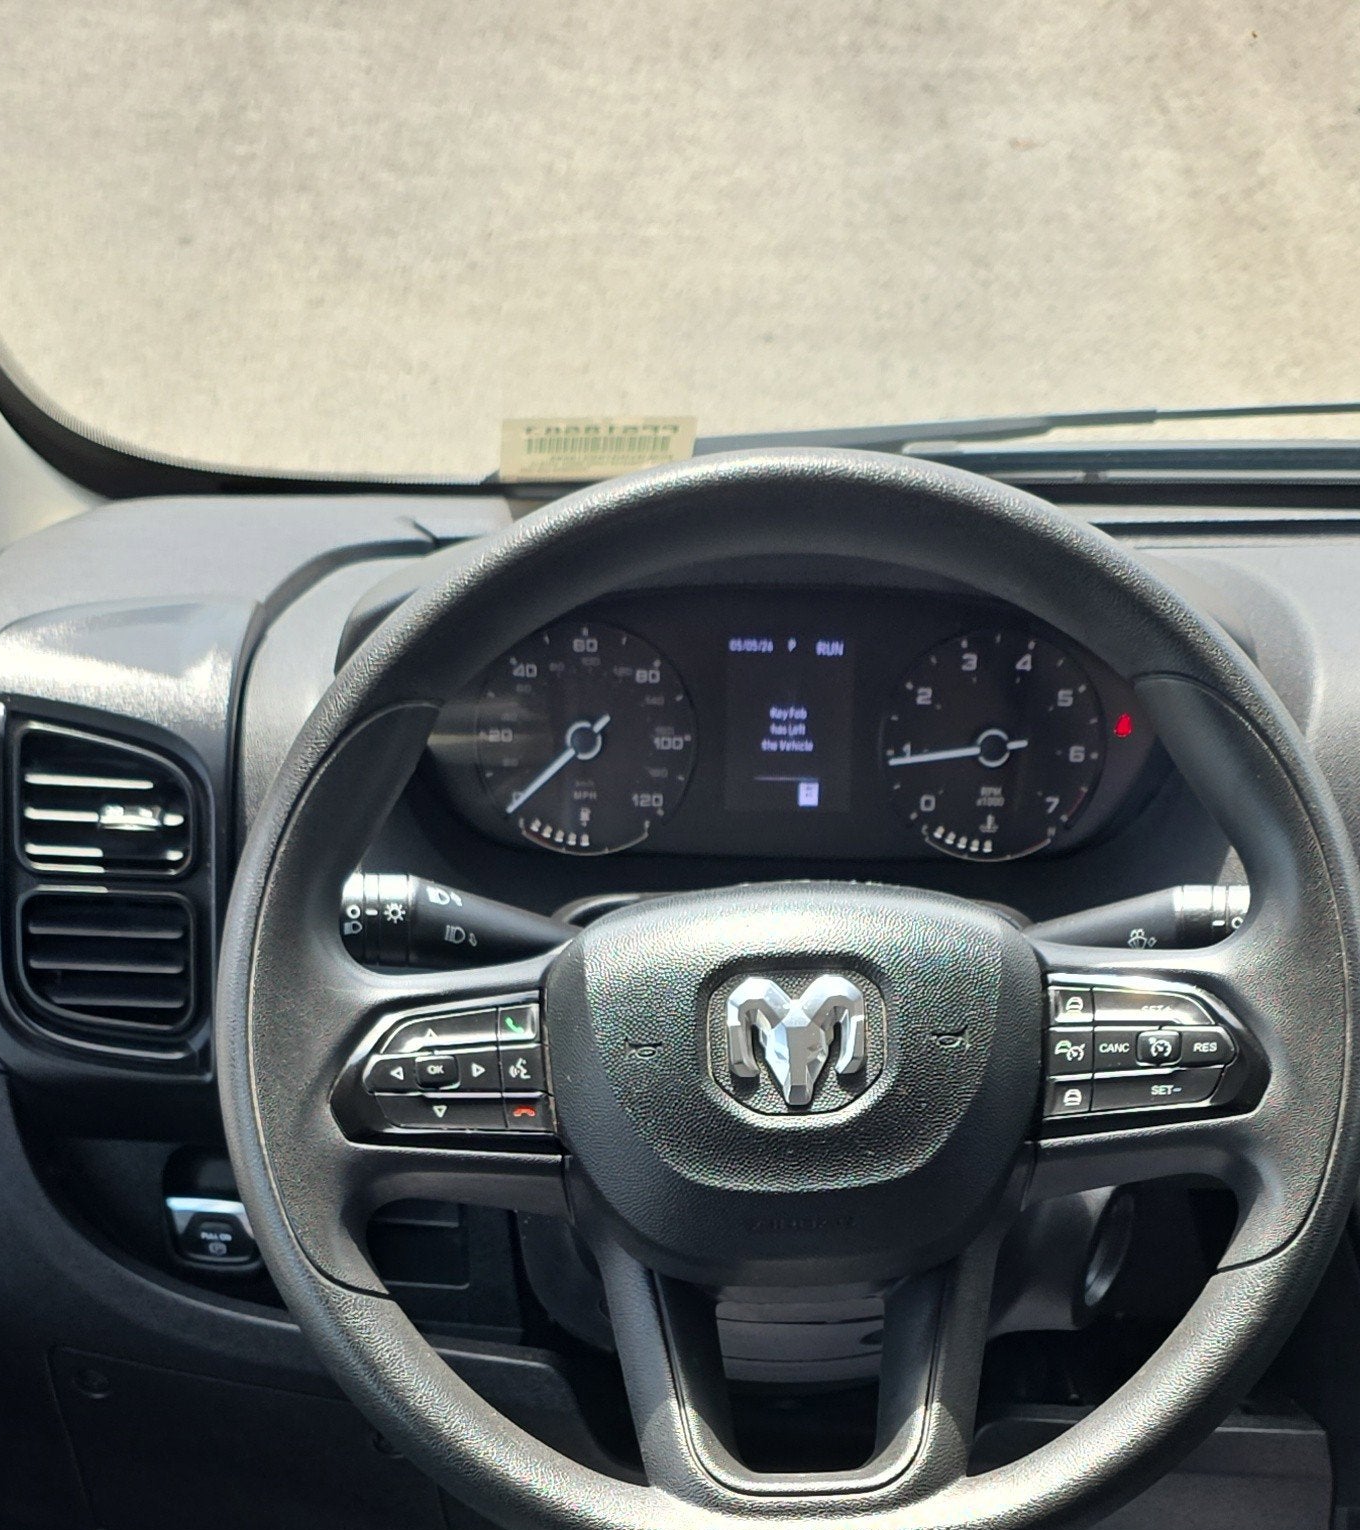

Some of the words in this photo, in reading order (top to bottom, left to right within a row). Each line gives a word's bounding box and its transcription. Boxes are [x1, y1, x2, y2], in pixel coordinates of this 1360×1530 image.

[572, 638, 598, 652] 60
[816, 640, 844, 656] RUN
[961, 653, 978, 671] 3
[1015, 653, 1032, 671] 4
[512, 663, 538, 678] 40
[635, 669, 661, 684] 80
[916, 687, 933, 705] 2
[1057, 689, 1074, 707] 5
[789, 706, 808, 720] Fob
[488, 727, 513, 742] 20
[653, 736, 684, 751] 100
[779, 739, 814, 752] Vehicle
[902, 742, 912, 758] 1
[1069, 745, 1086, 763] 6
[632, 793, 664, 808] 120
[920, 795, 936, 812] 0
[1046, 797, 1060, 814] 7
[1099, 1042, 1130, 1054] CANC
[1192, 1041, 1218, 1053] RES
[426, 1063, 445, 1075] OK
